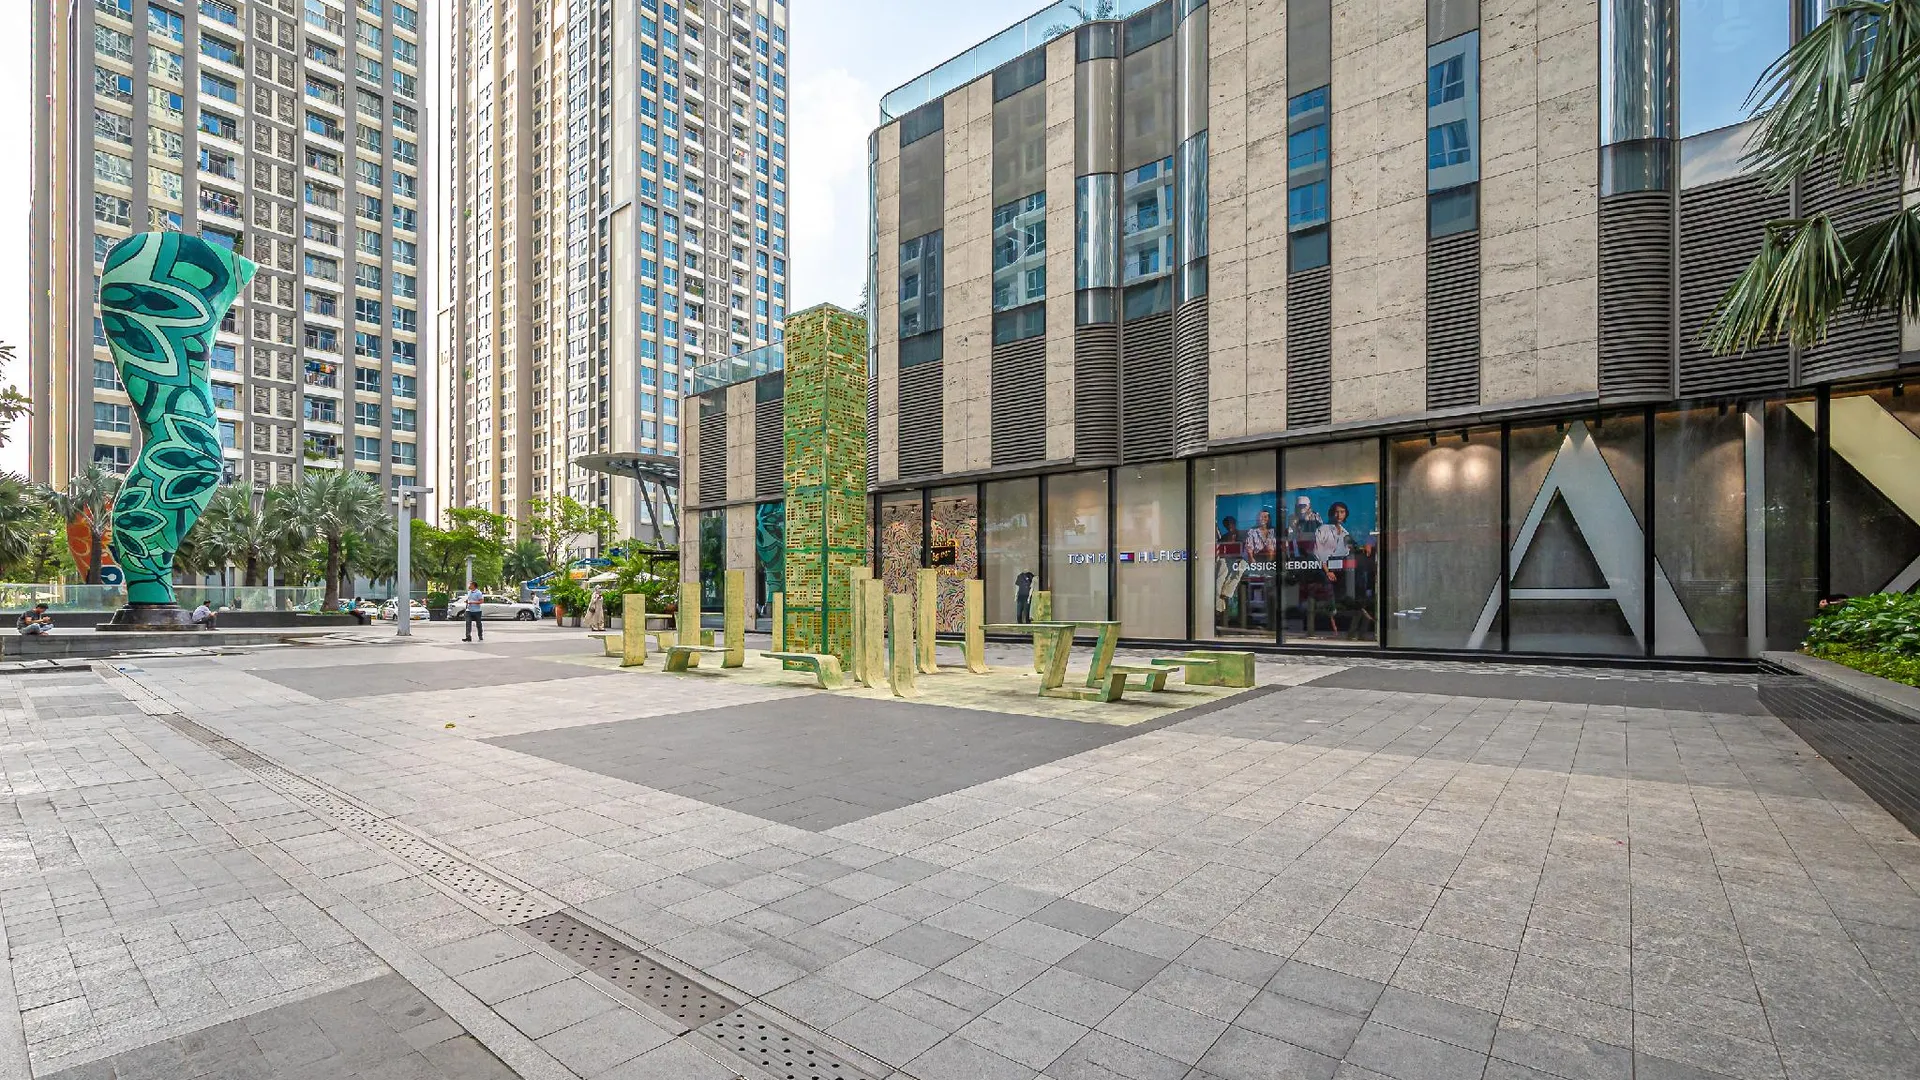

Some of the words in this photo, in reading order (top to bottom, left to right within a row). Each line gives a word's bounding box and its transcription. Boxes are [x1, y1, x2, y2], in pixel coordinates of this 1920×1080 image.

[1068, 553, 1107, 565] TOMM
[1138, 550, 1198, 562] HILFIGE
[1232, 561, 1276, 571] CASSICS
